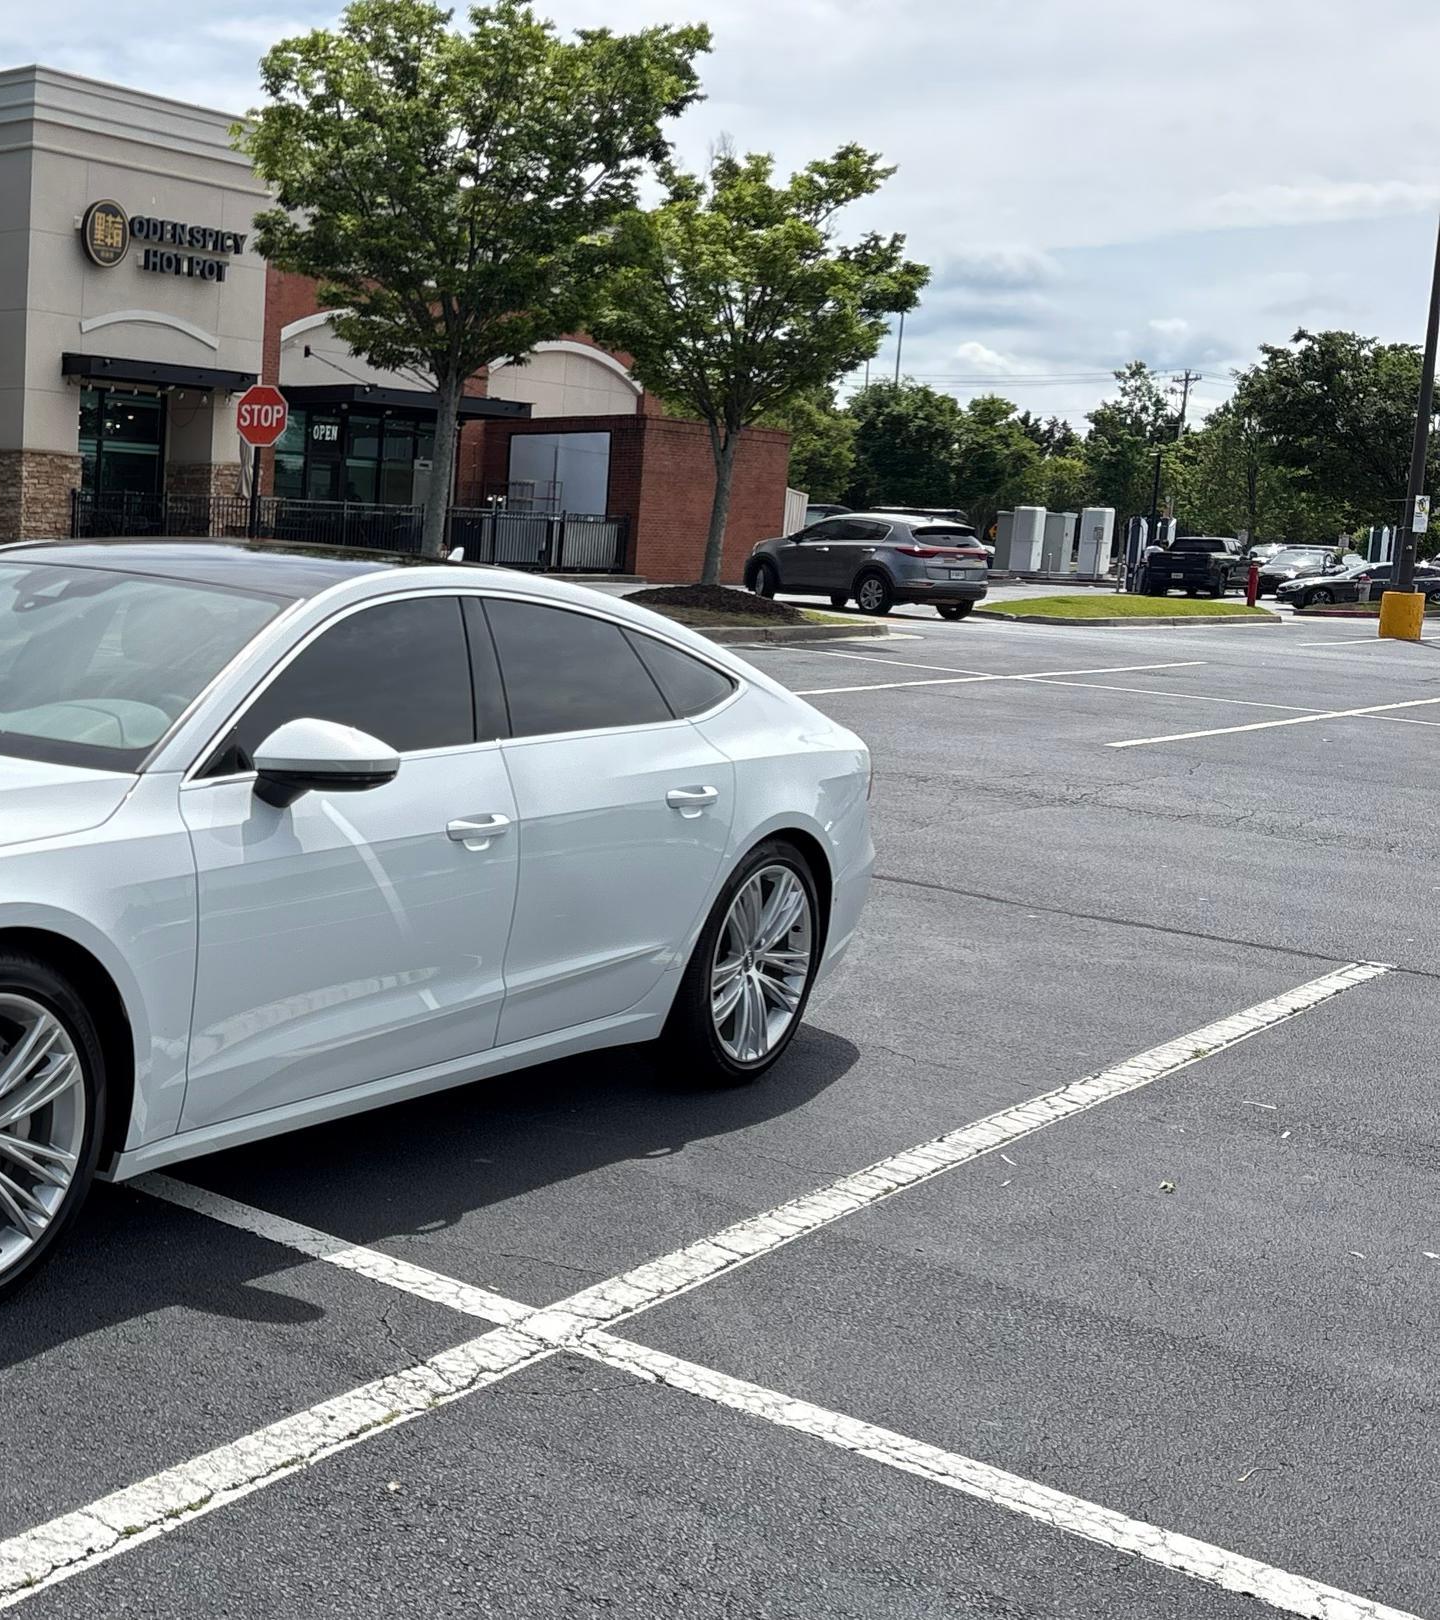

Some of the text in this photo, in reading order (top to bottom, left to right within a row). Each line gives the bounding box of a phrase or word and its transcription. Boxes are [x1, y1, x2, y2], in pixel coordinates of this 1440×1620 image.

[130, 215, 189, 247] ODEN
[189, 225, 248, 255] SPICY
[143, 249, 230, 283] HOT POT
[240, 404, 284, 427] STOP
[312, 424, 339, 441] OPEN
